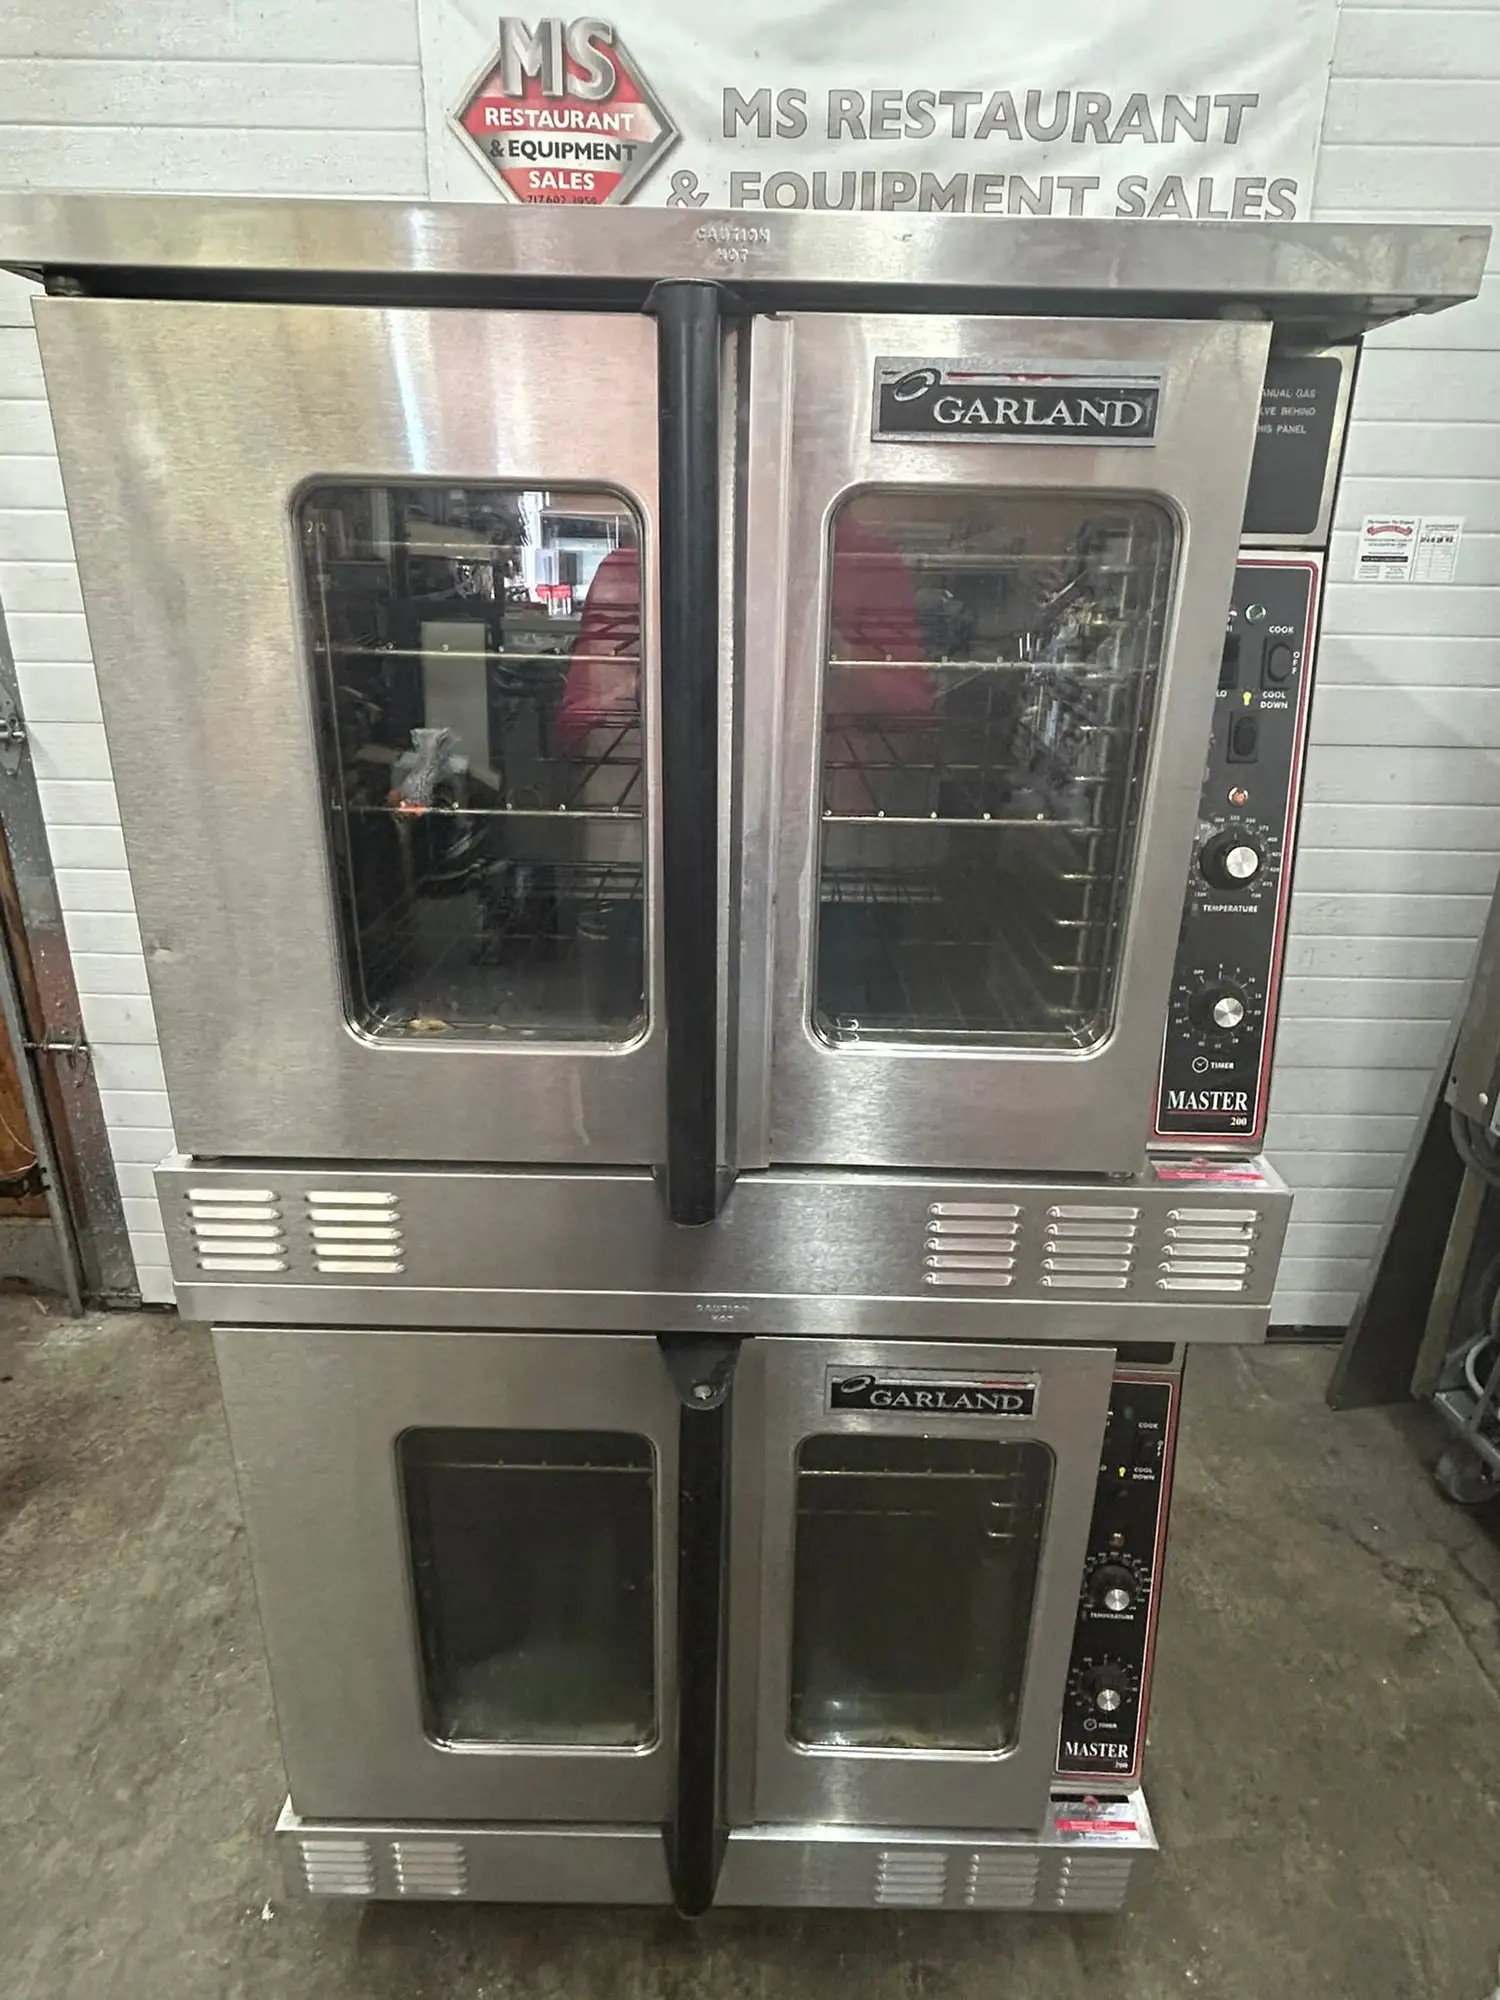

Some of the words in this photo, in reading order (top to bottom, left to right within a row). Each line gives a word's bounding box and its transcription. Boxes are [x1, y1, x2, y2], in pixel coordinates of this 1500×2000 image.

[498, 15, 616, 101] MS
[484, 107, 635, 131] RESTAURANT
[722, 87, 807, 139] MS
[827, 89, 1259, 144] RESTAURANT
[490, 139, 505, 157] &
[508, 139, 638, 161] EQUIPMENT
[528, 170, 595, 190] SALES
[666, 169, 709, 208] &
[730, 171, 1100, 214] EQUIPMENT
[1116, 174, 1298, 220] SALES
[932, 396, 1143, 427] GARLAND
[1276, 423, 1307, 434] PANEL
[1268, 625, 1294, 634] COOK
[1262, 690, 1286, 699] COOL
[1260, 701, 1289, 710] DOWN
[1203, 904, 1258, 914] TEMPERATURE
[1210, 1062, 1235, 1070] TIMER
[1167, 1090, 1248, 1111] MASTER
[1230, 1116, 1248, 1127] 200
[869, 1389, 1024, 1411] GARLAND
[1065, 1741, 1129, 1758] MASTER
